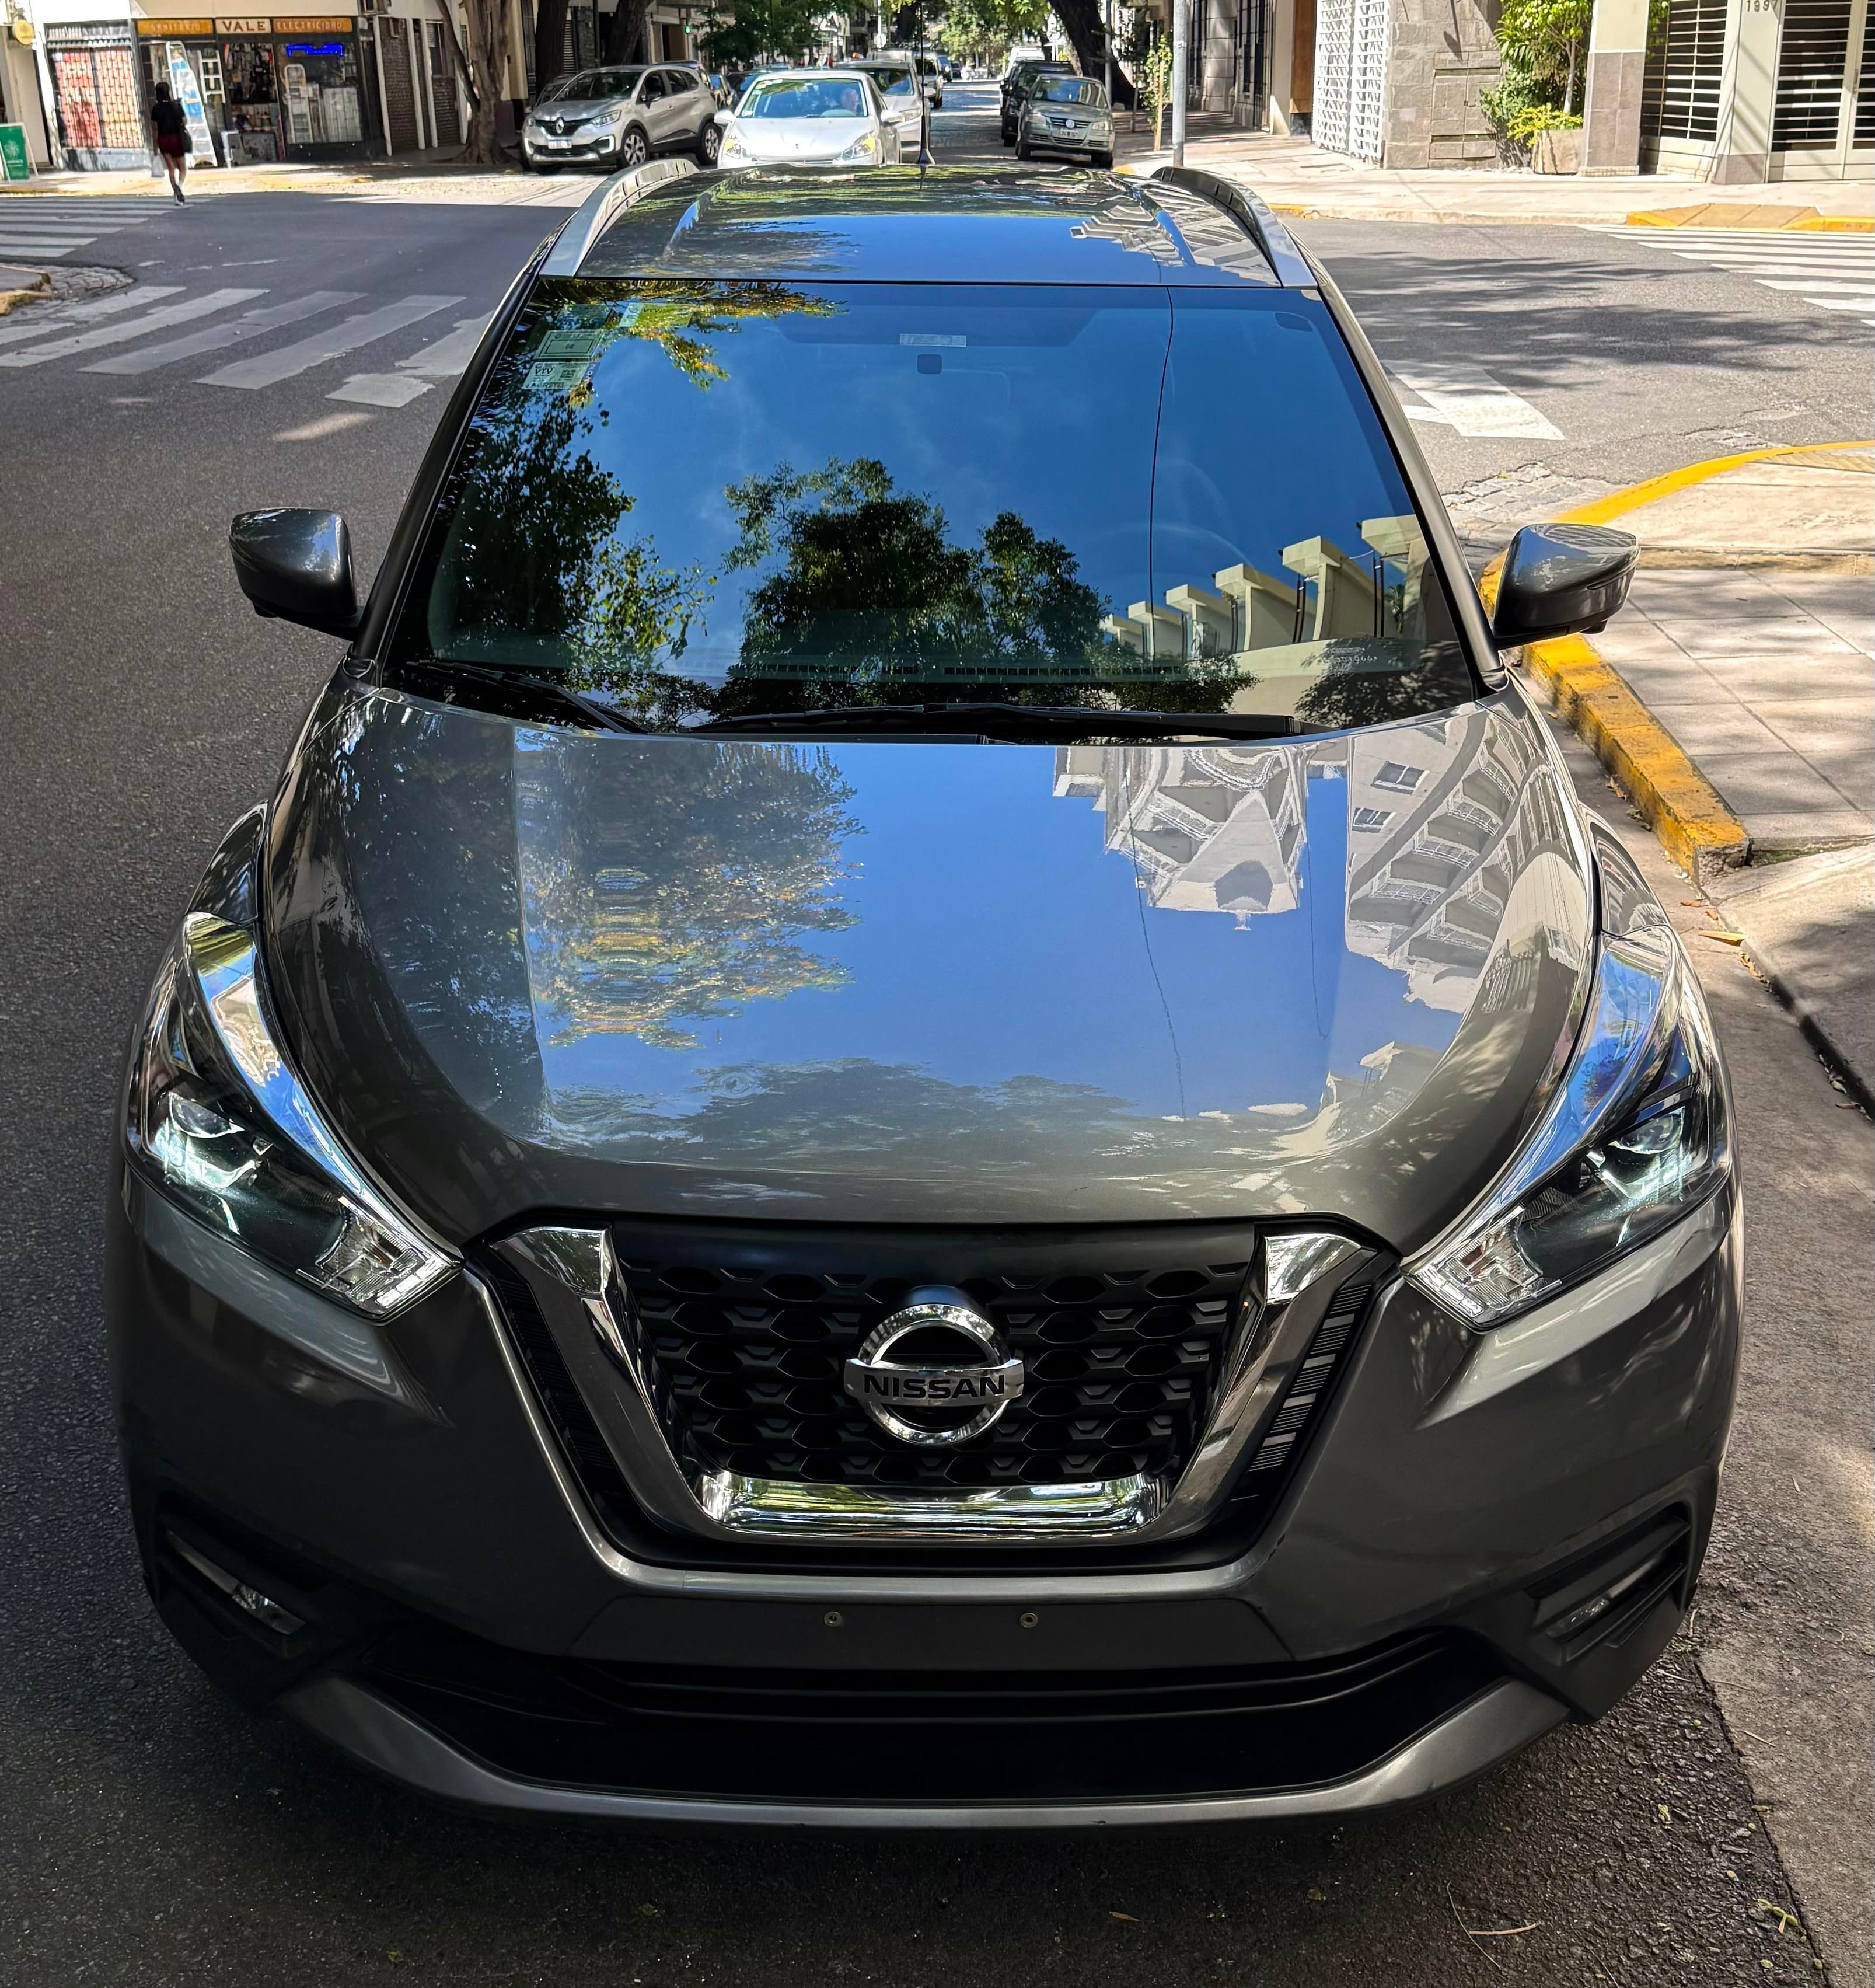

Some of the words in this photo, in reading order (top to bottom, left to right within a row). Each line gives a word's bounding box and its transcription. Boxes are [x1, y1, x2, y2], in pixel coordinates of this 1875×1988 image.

[222, 20, 266, 32] VALE
[277, 20, 343, 30] ELECTRICIDAD
[864, 1374, 1005, 1399] NISSAN
